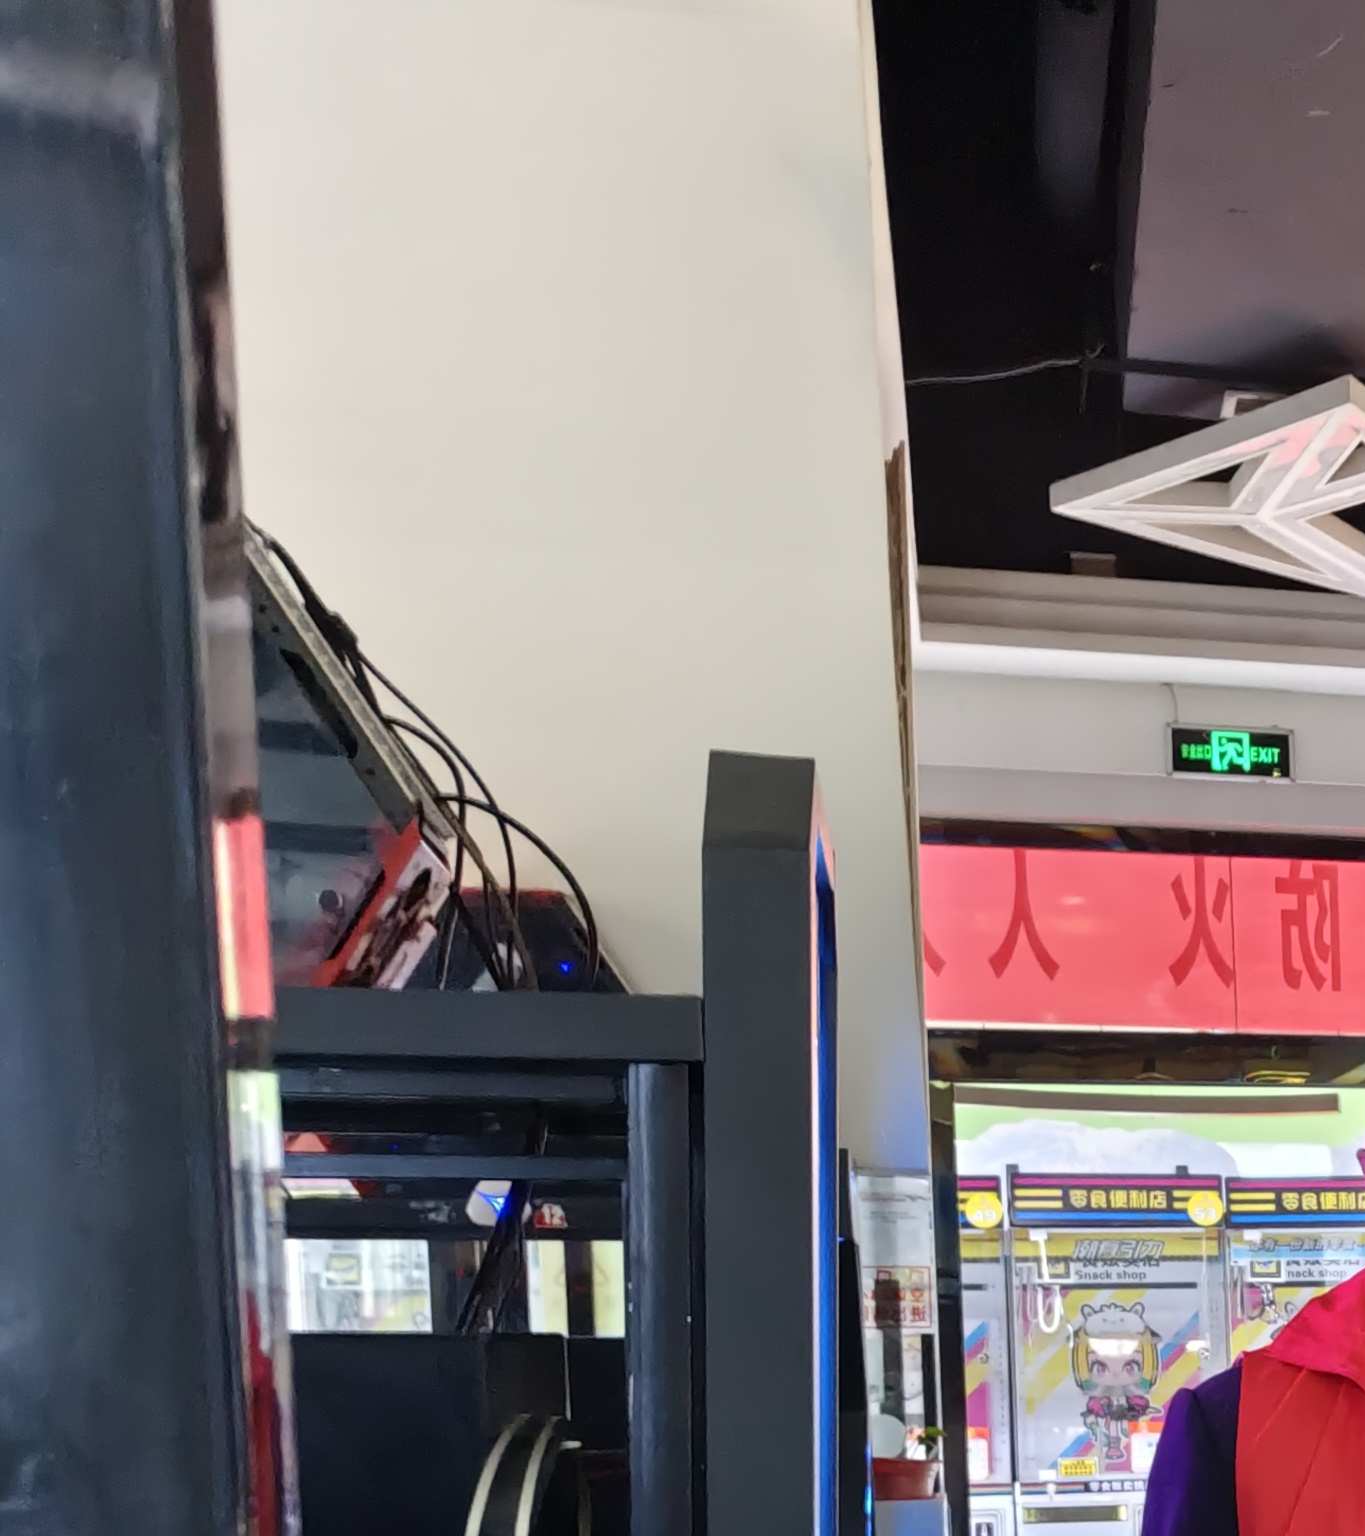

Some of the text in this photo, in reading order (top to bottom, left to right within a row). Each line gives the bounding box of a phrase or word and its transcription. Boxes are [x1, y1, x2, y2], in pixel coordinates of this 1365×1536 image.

[1250, 746, 1281, 763] EXIT
[1068, 1189, 1168, 1209] 零食便利店
[1075, 1269, 1148, 1281] Snack shop
